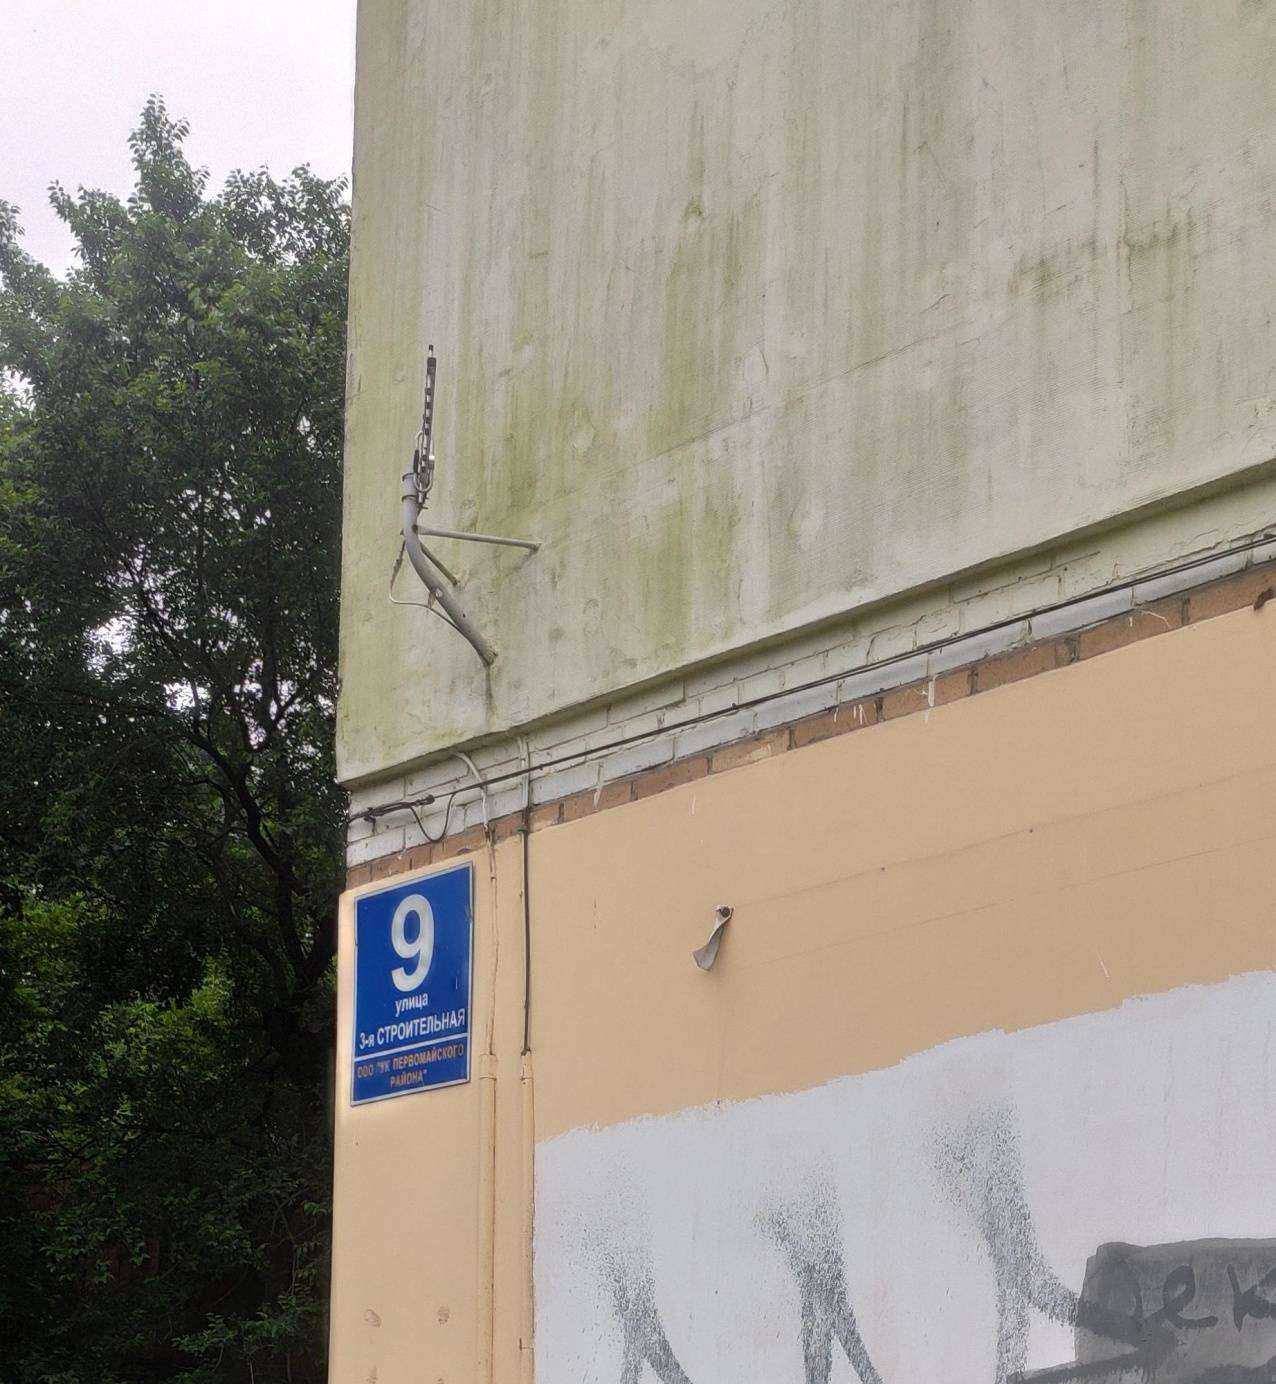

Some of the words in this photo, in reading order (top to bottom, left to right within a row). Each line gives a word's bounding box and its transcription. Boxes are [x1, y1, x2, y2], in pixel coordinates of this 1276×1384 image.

[391, 893, 435, 992] 9
[395, 993, 429, 1017] улица
[360, 1032, 375, 1049] 3-я
[376, 1008, 465, 1045] СТРОИТЕЛЬНАЯ
[357, 1064, 374, 1078] ООО
[392, 1043, 464, 1071] ПЕРВОМАЙСКОГО
